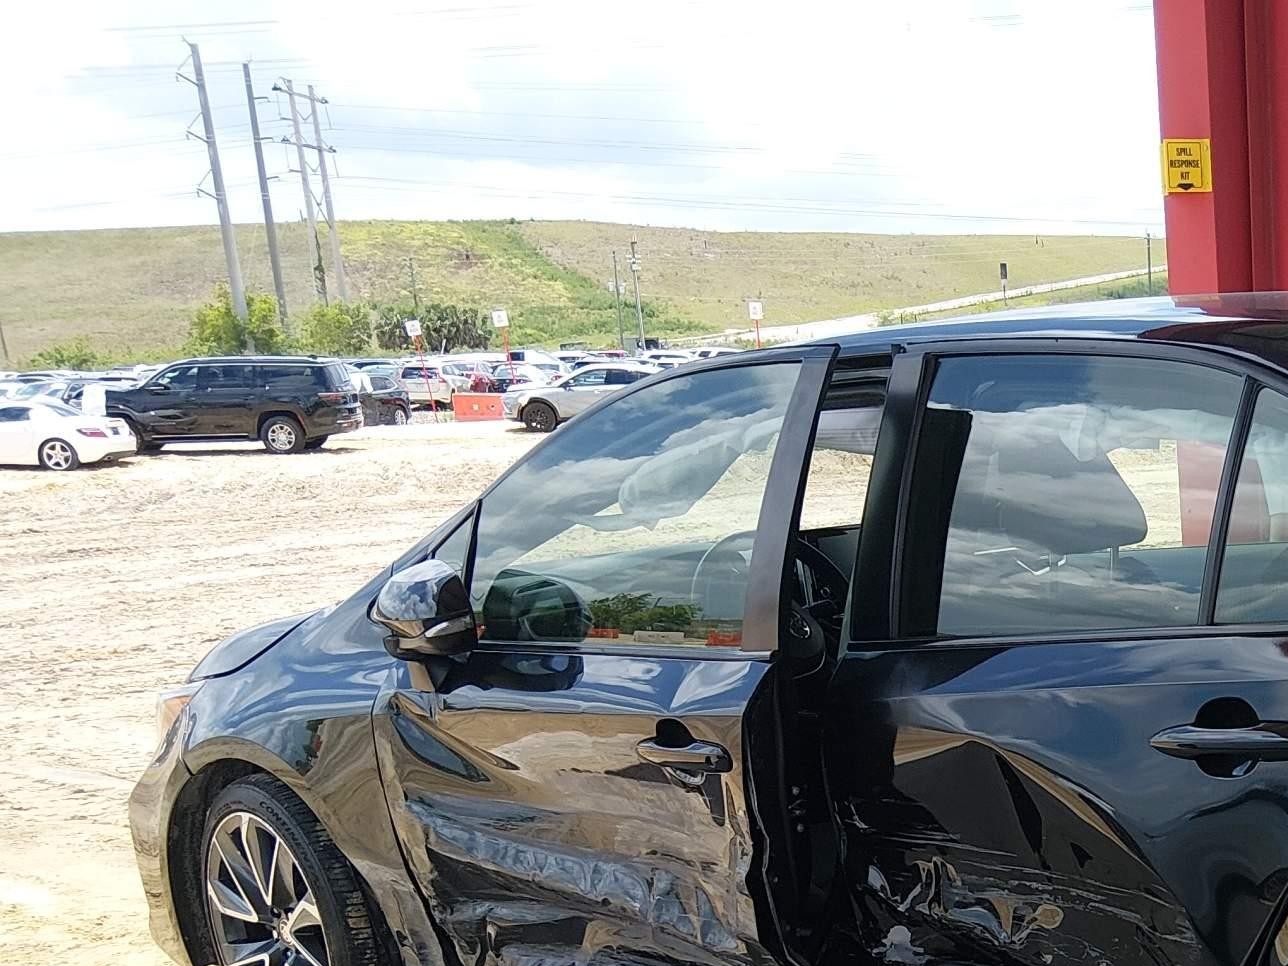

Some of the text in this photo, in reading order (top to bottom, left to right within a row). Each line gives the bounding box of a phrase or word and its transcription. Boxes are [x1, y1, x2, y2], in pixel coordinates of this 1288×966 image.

[1176, 148, 1193, 157] SPILL
[1170, 160, 1200, 168] RESPONSE
[1181, 172, 1190, 180] KIT
